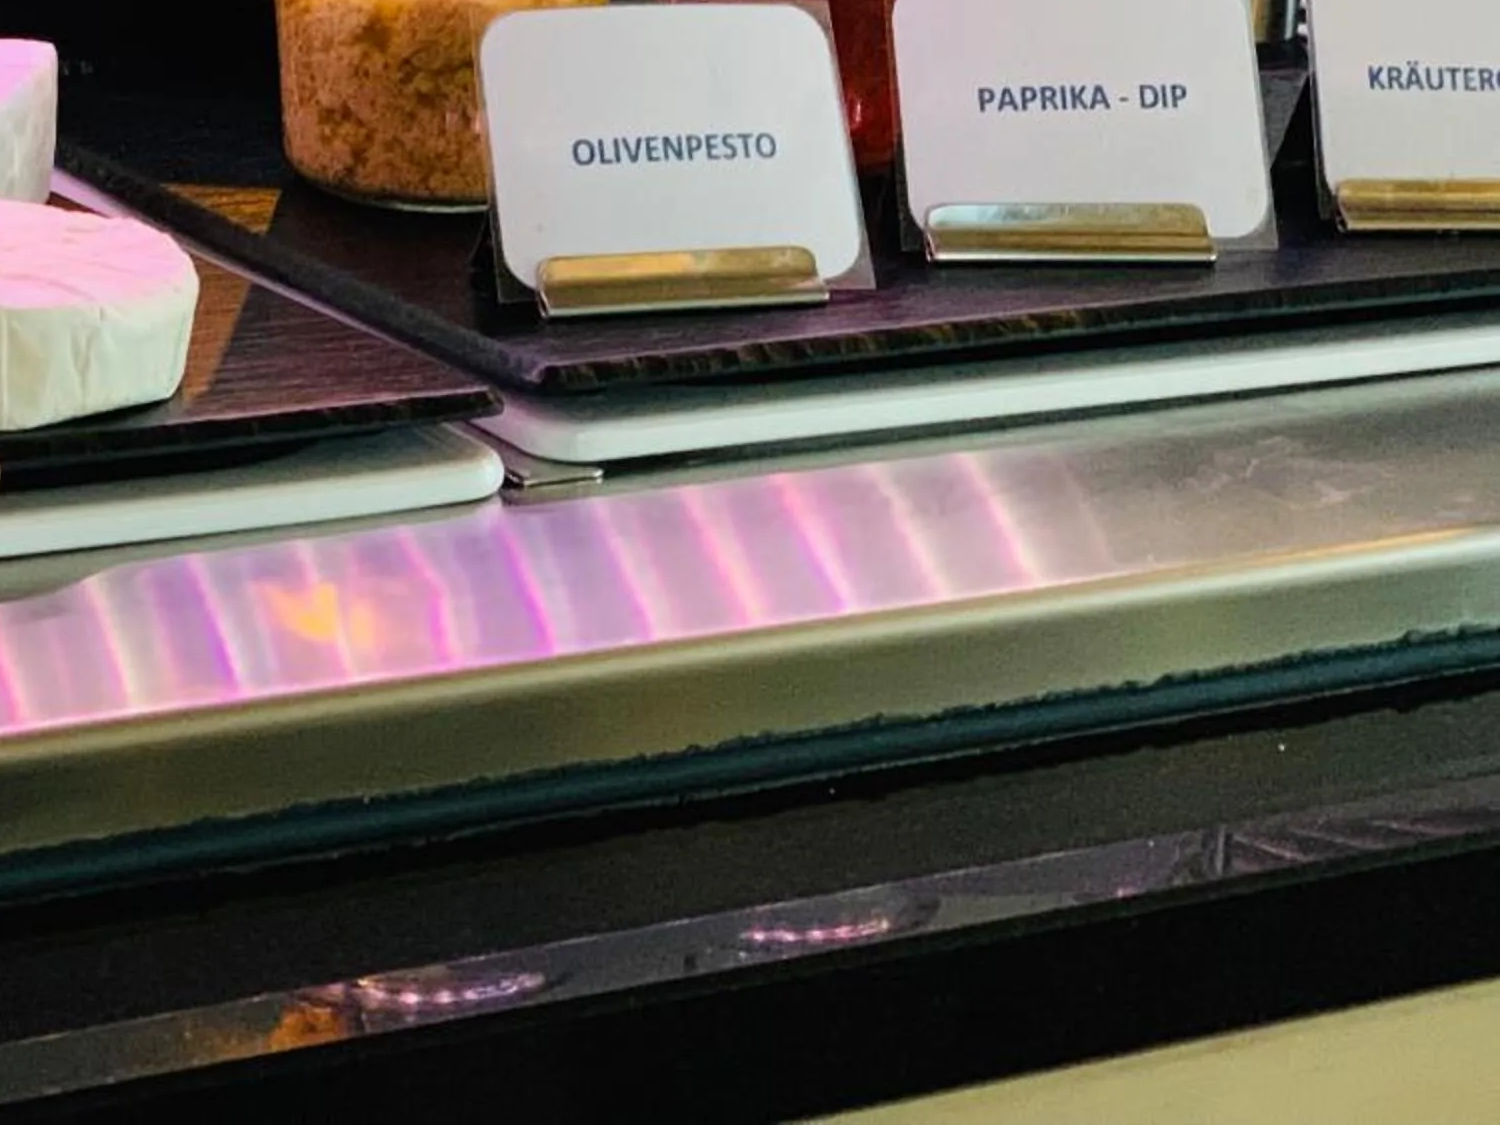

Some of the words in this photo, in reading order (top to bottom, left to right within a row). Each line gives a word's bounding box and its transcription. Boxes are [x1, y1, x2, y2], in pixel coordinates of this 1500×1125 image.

[1367, 60, 1500, 92] KRÄUTER
[977, 84, 1111, 113] PAPRIKA
[1138, 83, 1188, 110] DIP
[571, 132, 777, 167] OLIVENPESTO
